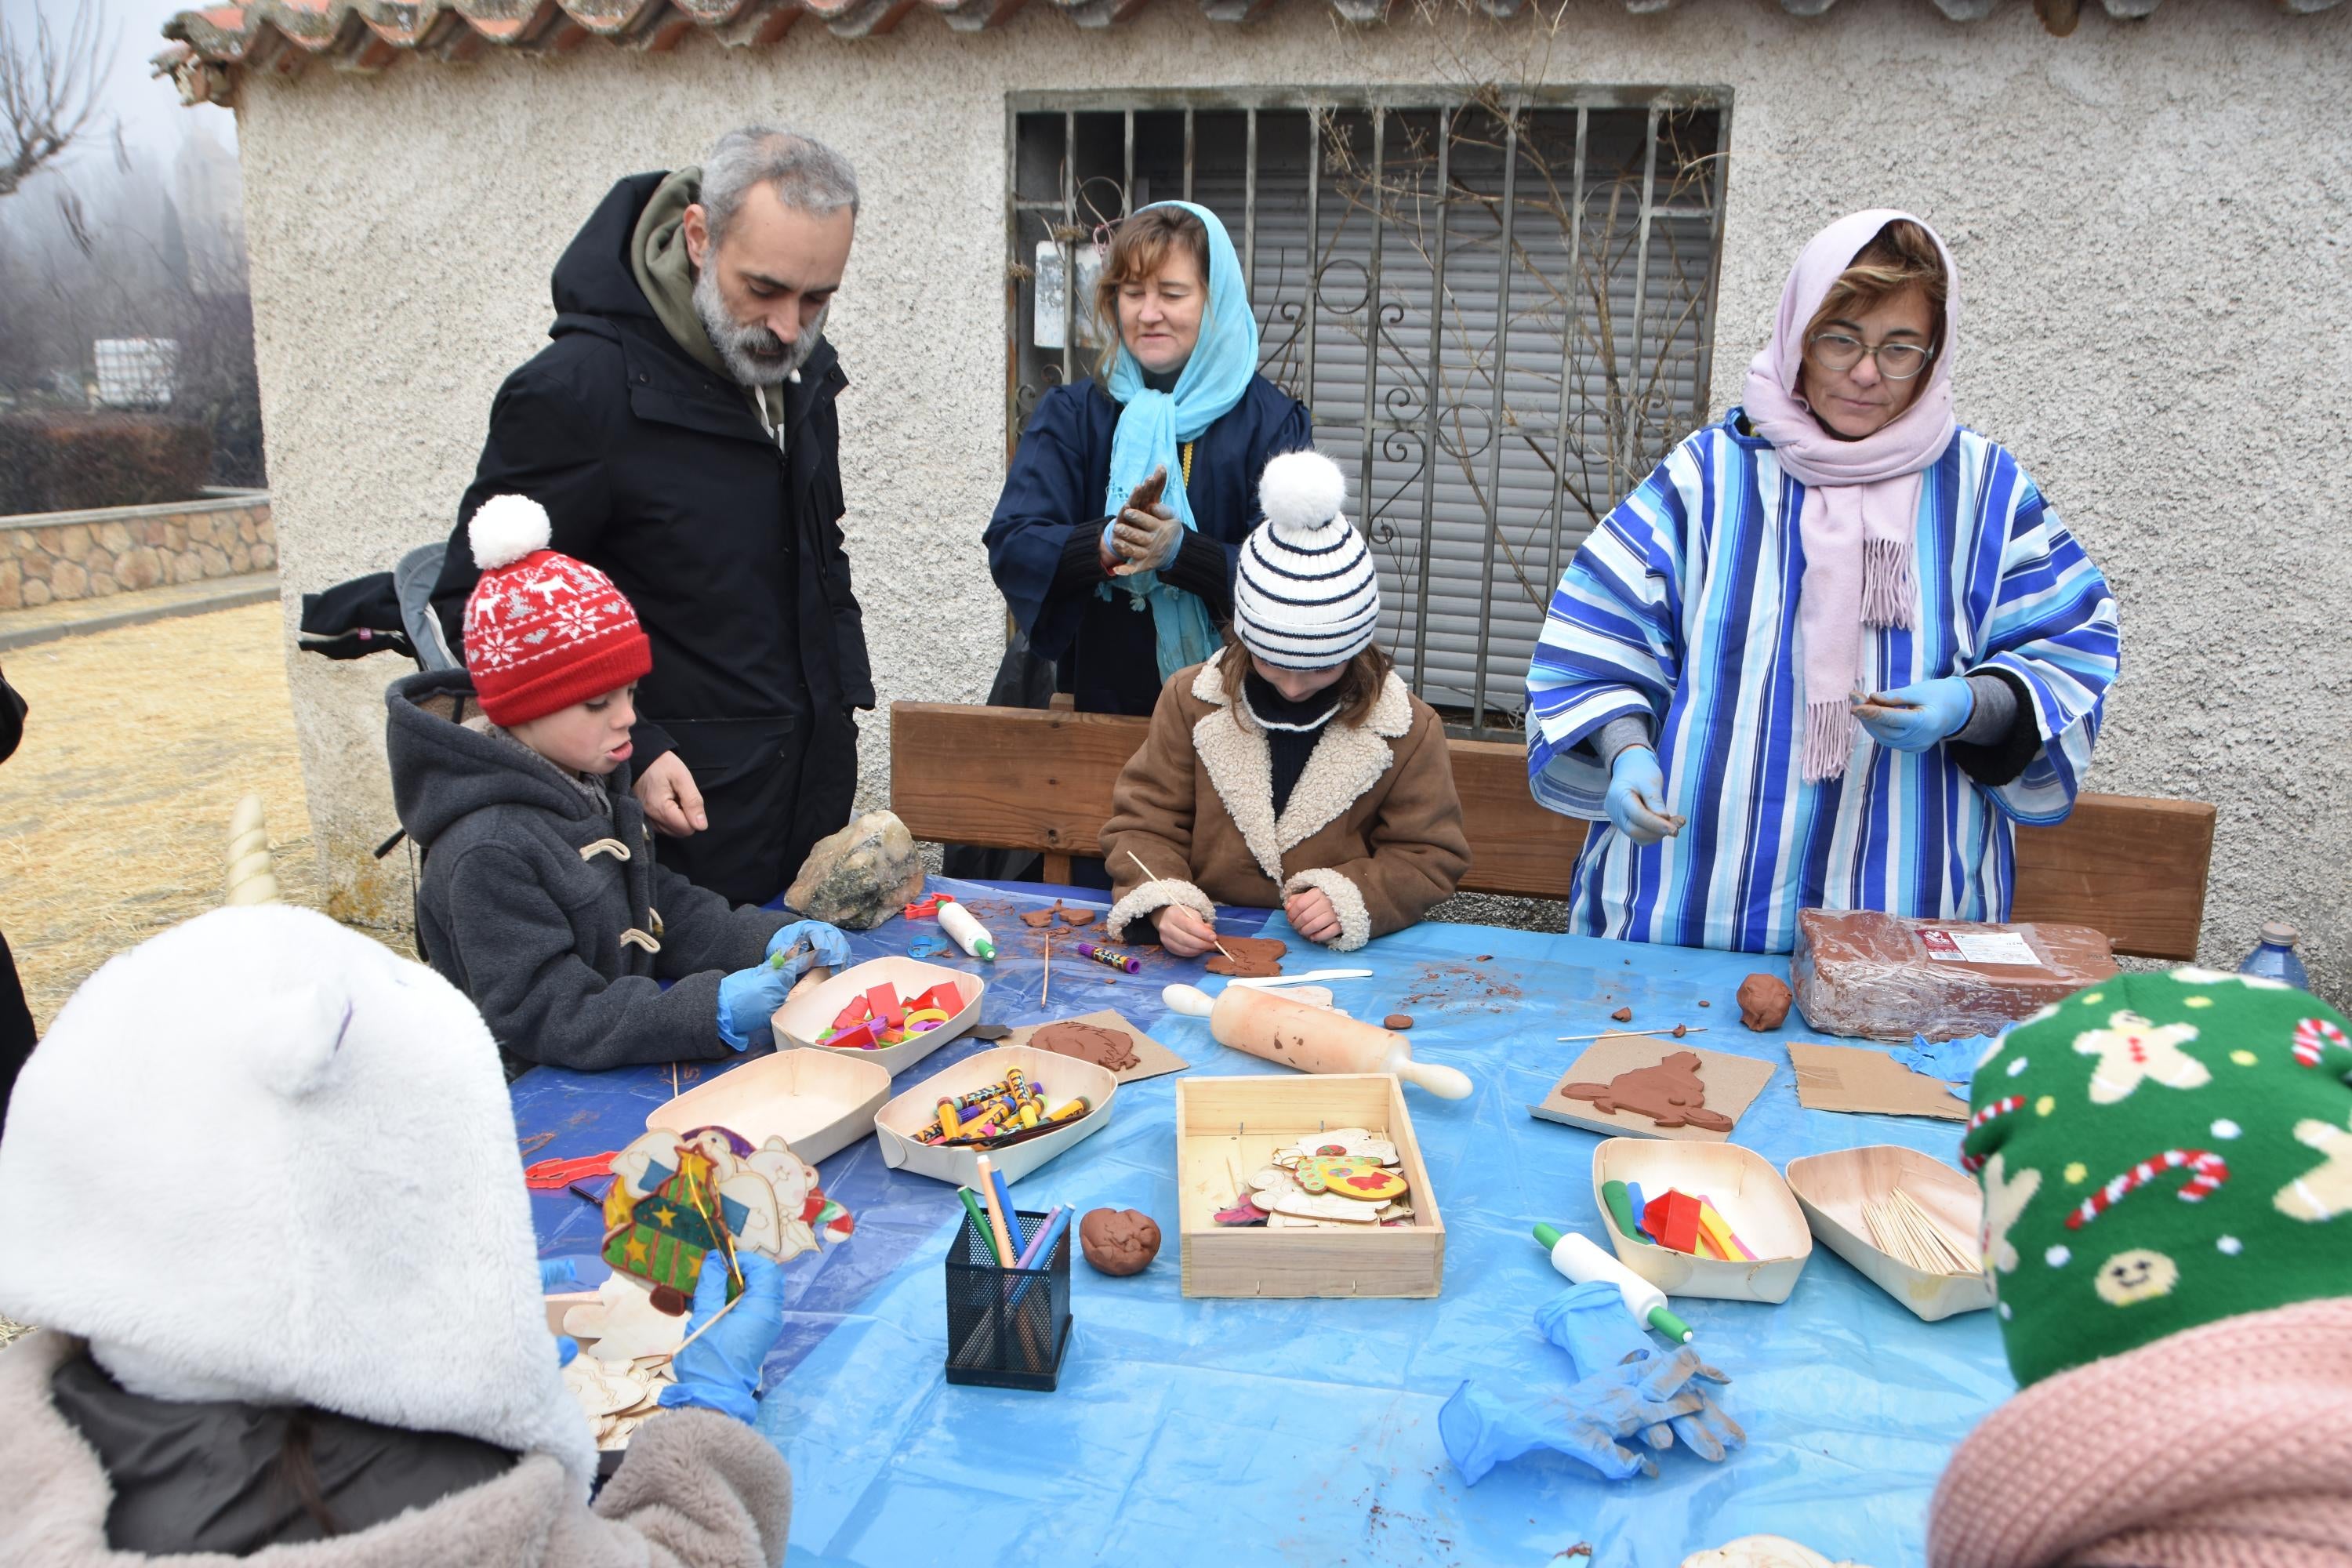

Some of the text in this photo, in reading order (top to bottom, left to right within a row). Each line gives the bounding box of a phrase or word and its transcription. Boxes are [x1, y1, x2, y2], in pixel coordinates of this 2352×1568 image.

[966, 1084, 1003, 1099] ART
[1011, 1075, 1028, 1100] ART
[923, 1121, 942, 1142] AR
